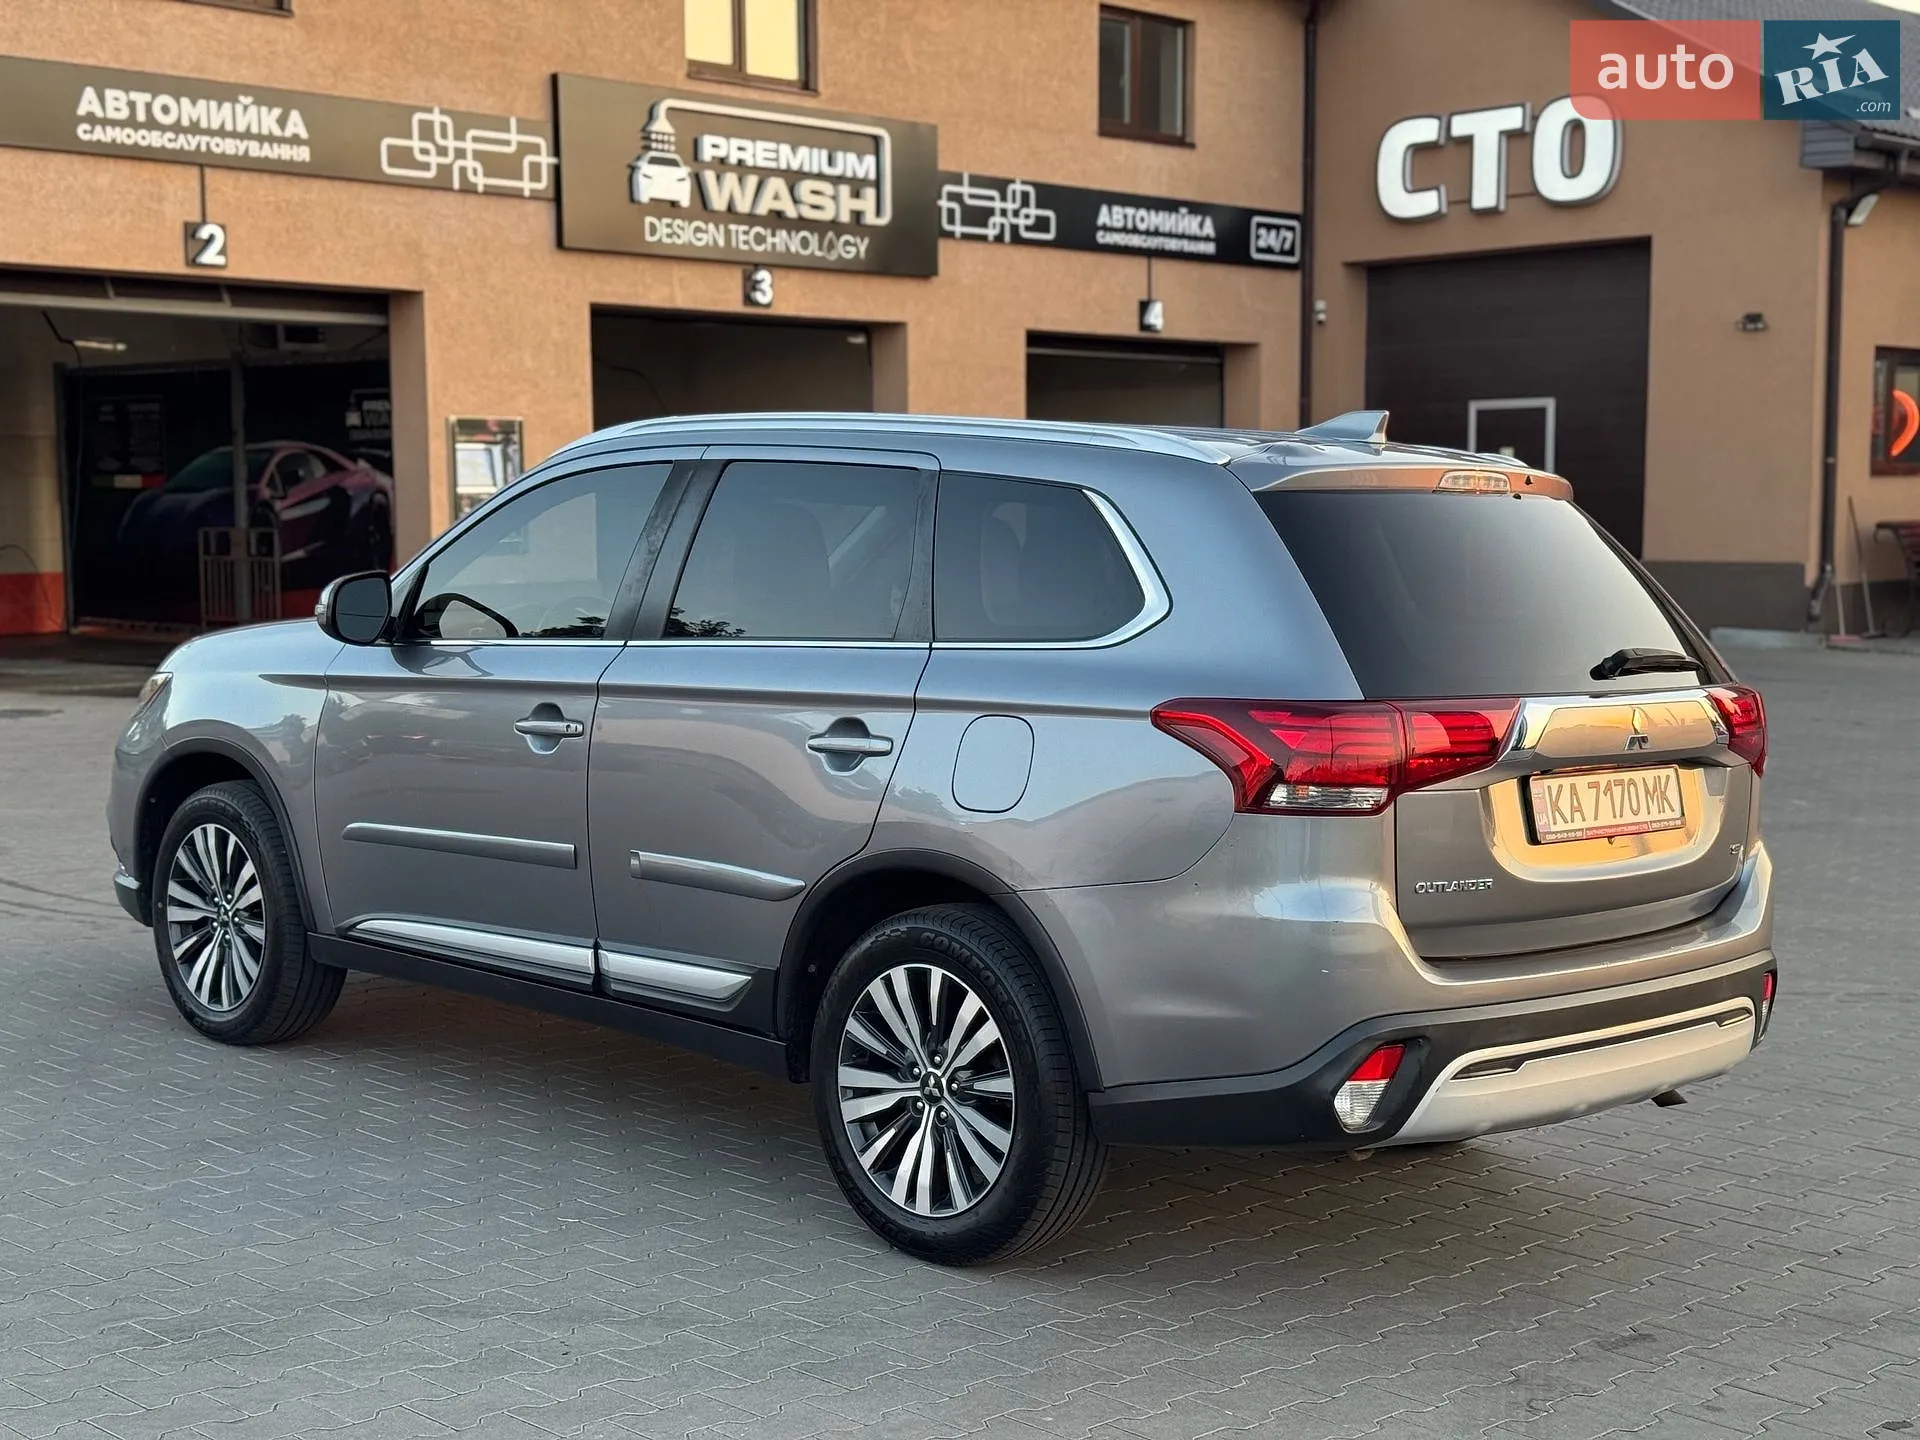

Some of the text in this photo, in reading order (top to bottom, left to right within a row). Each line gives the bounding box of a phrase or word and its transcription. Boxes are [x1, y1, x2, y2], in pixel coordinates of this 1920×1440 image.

[76, 85, 309, 140] АВТОМИЙКА
[76, 122, 311, 163] САМООБСЛУГОВУВАННЯ
[696, 133, 877, 181] PREMIUM
[1377, 96, 1622, 221] СТО
[700, 169, 877, 225] WASH
[644, 215, 725, 249] DESIGN
[1096, 203, 1216, 239] АВТОМИЙКА
[1256, 225, 1295, 253] 24/7
[194, 223, 227, 265] 2
[750, 269, 774, 305] 3
[1143, 300, 1164, 332] 4
[1547, 774, 1675, 825] KA 7170 MK
[1415, 877, 1494, 894] OUTLANDER
